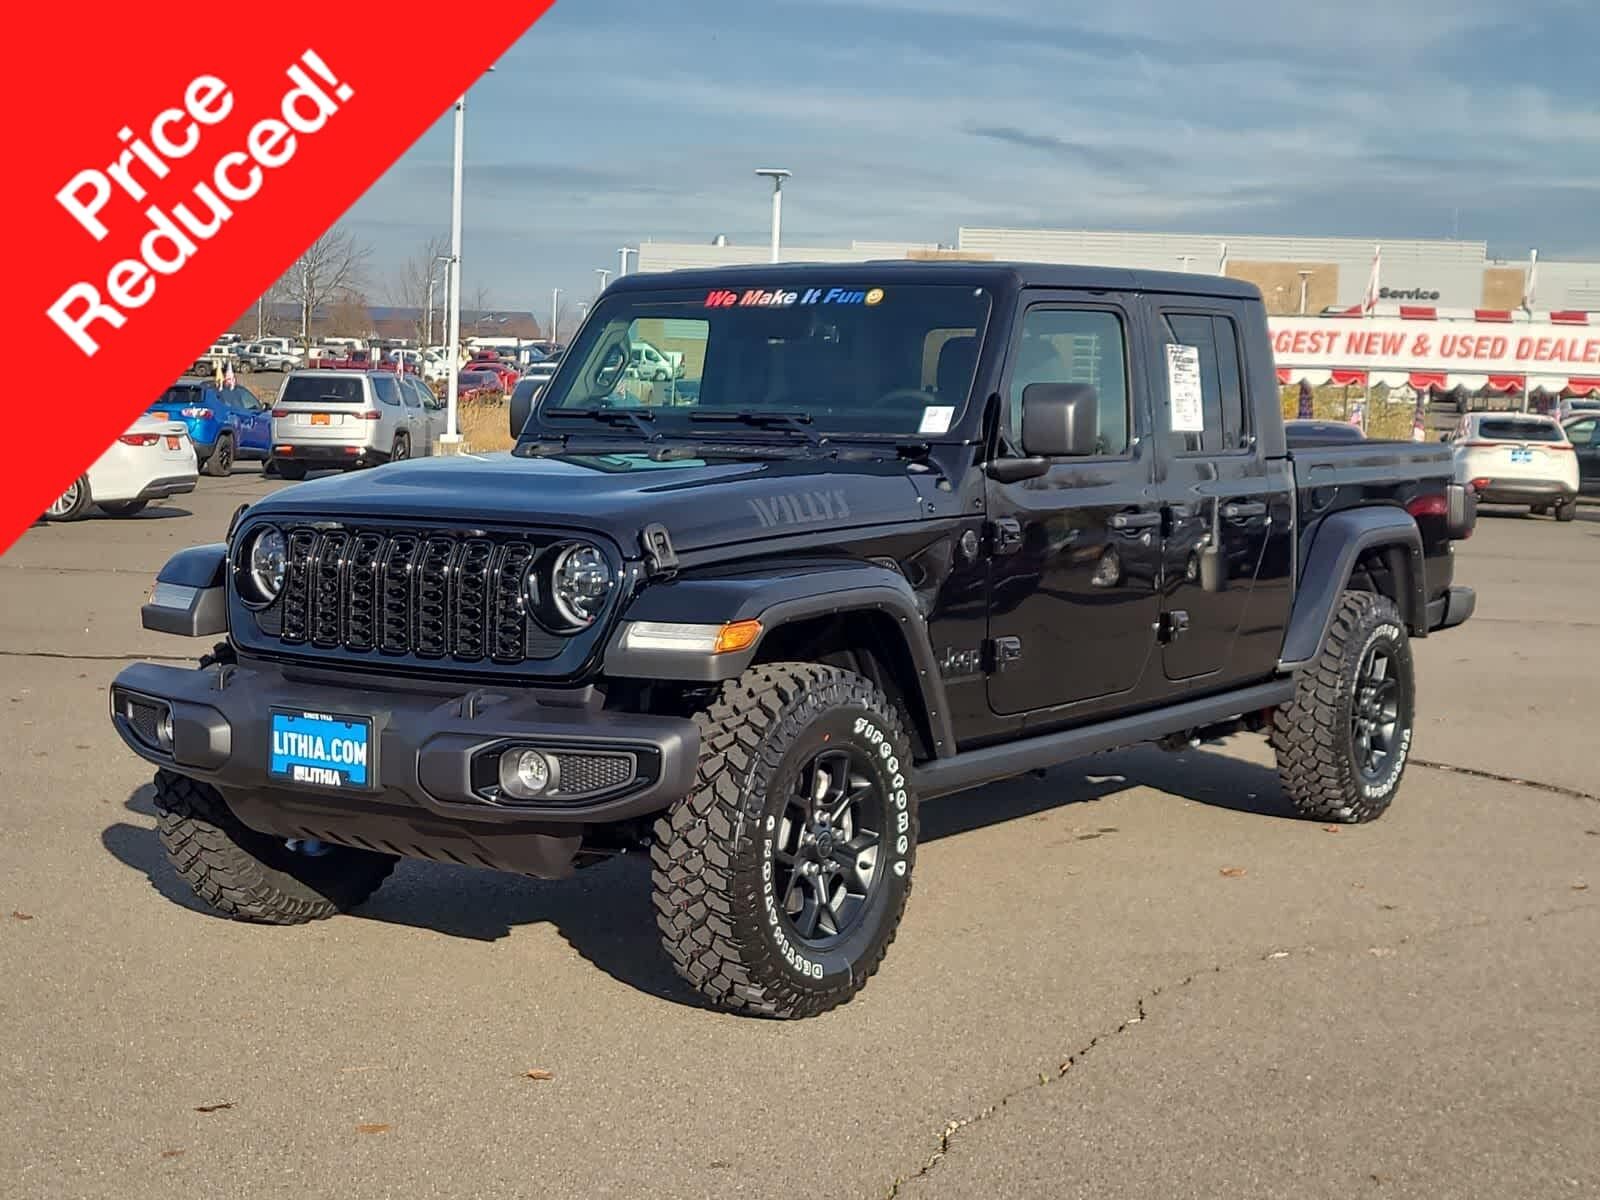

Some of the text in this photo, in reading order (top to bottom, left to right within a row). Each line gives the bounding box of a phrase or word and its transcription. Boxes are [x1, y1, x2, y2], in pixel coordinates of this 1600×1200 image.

[705, 288, 865, 306] We Make It Fun
[1379, 287, 1440, 300] Service
[1266, 330, 1600, 363] GEST NEW & USED DEALE
[746, 489, 850, 528] WILLYS
[273, 730, 368, 767] LITHIA.COM
[305, 766, 341, 786] LITHIA
